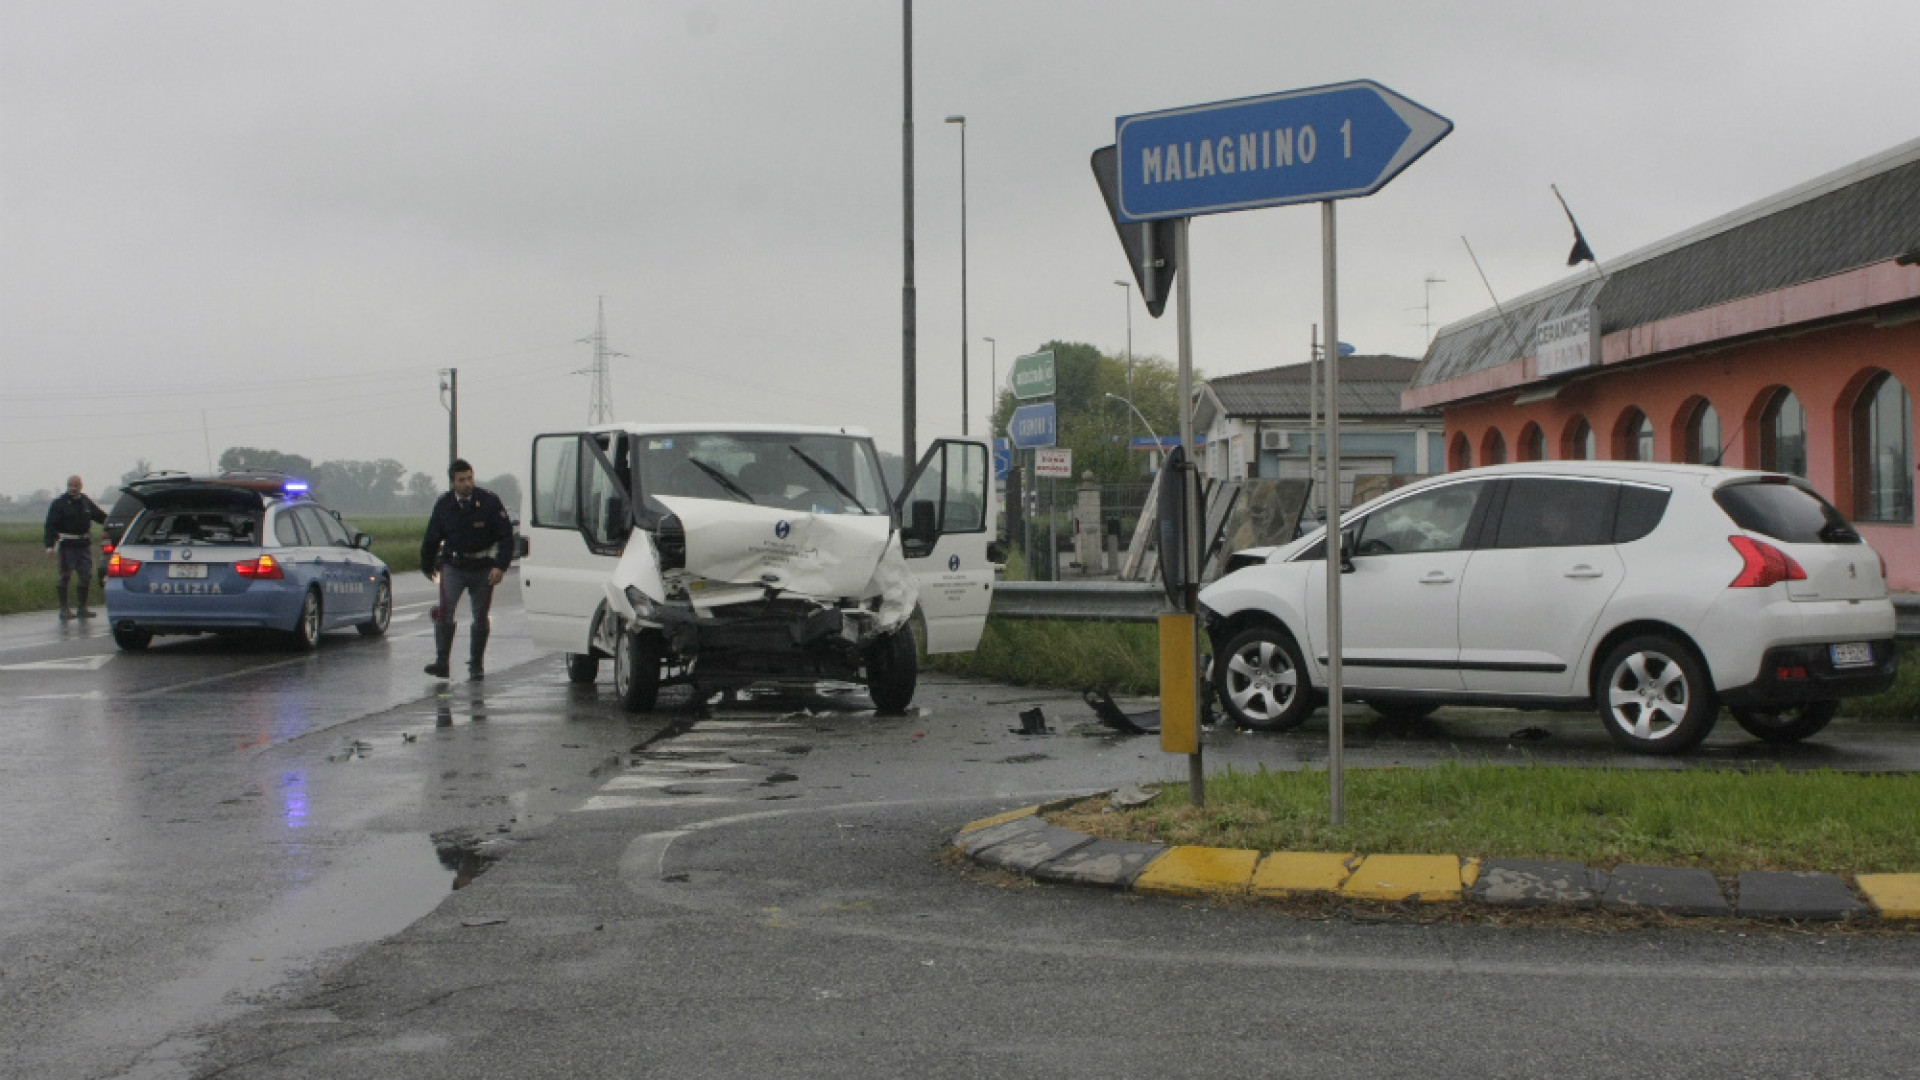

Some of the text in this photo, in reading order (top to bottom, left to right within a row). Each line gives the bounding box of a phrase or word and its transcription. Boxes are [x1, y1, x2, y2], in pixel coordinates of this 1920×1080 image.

[1142, 118, 1352, 185] MALAGNINO 1
[149, 582, 222, 594] POLIZIA
